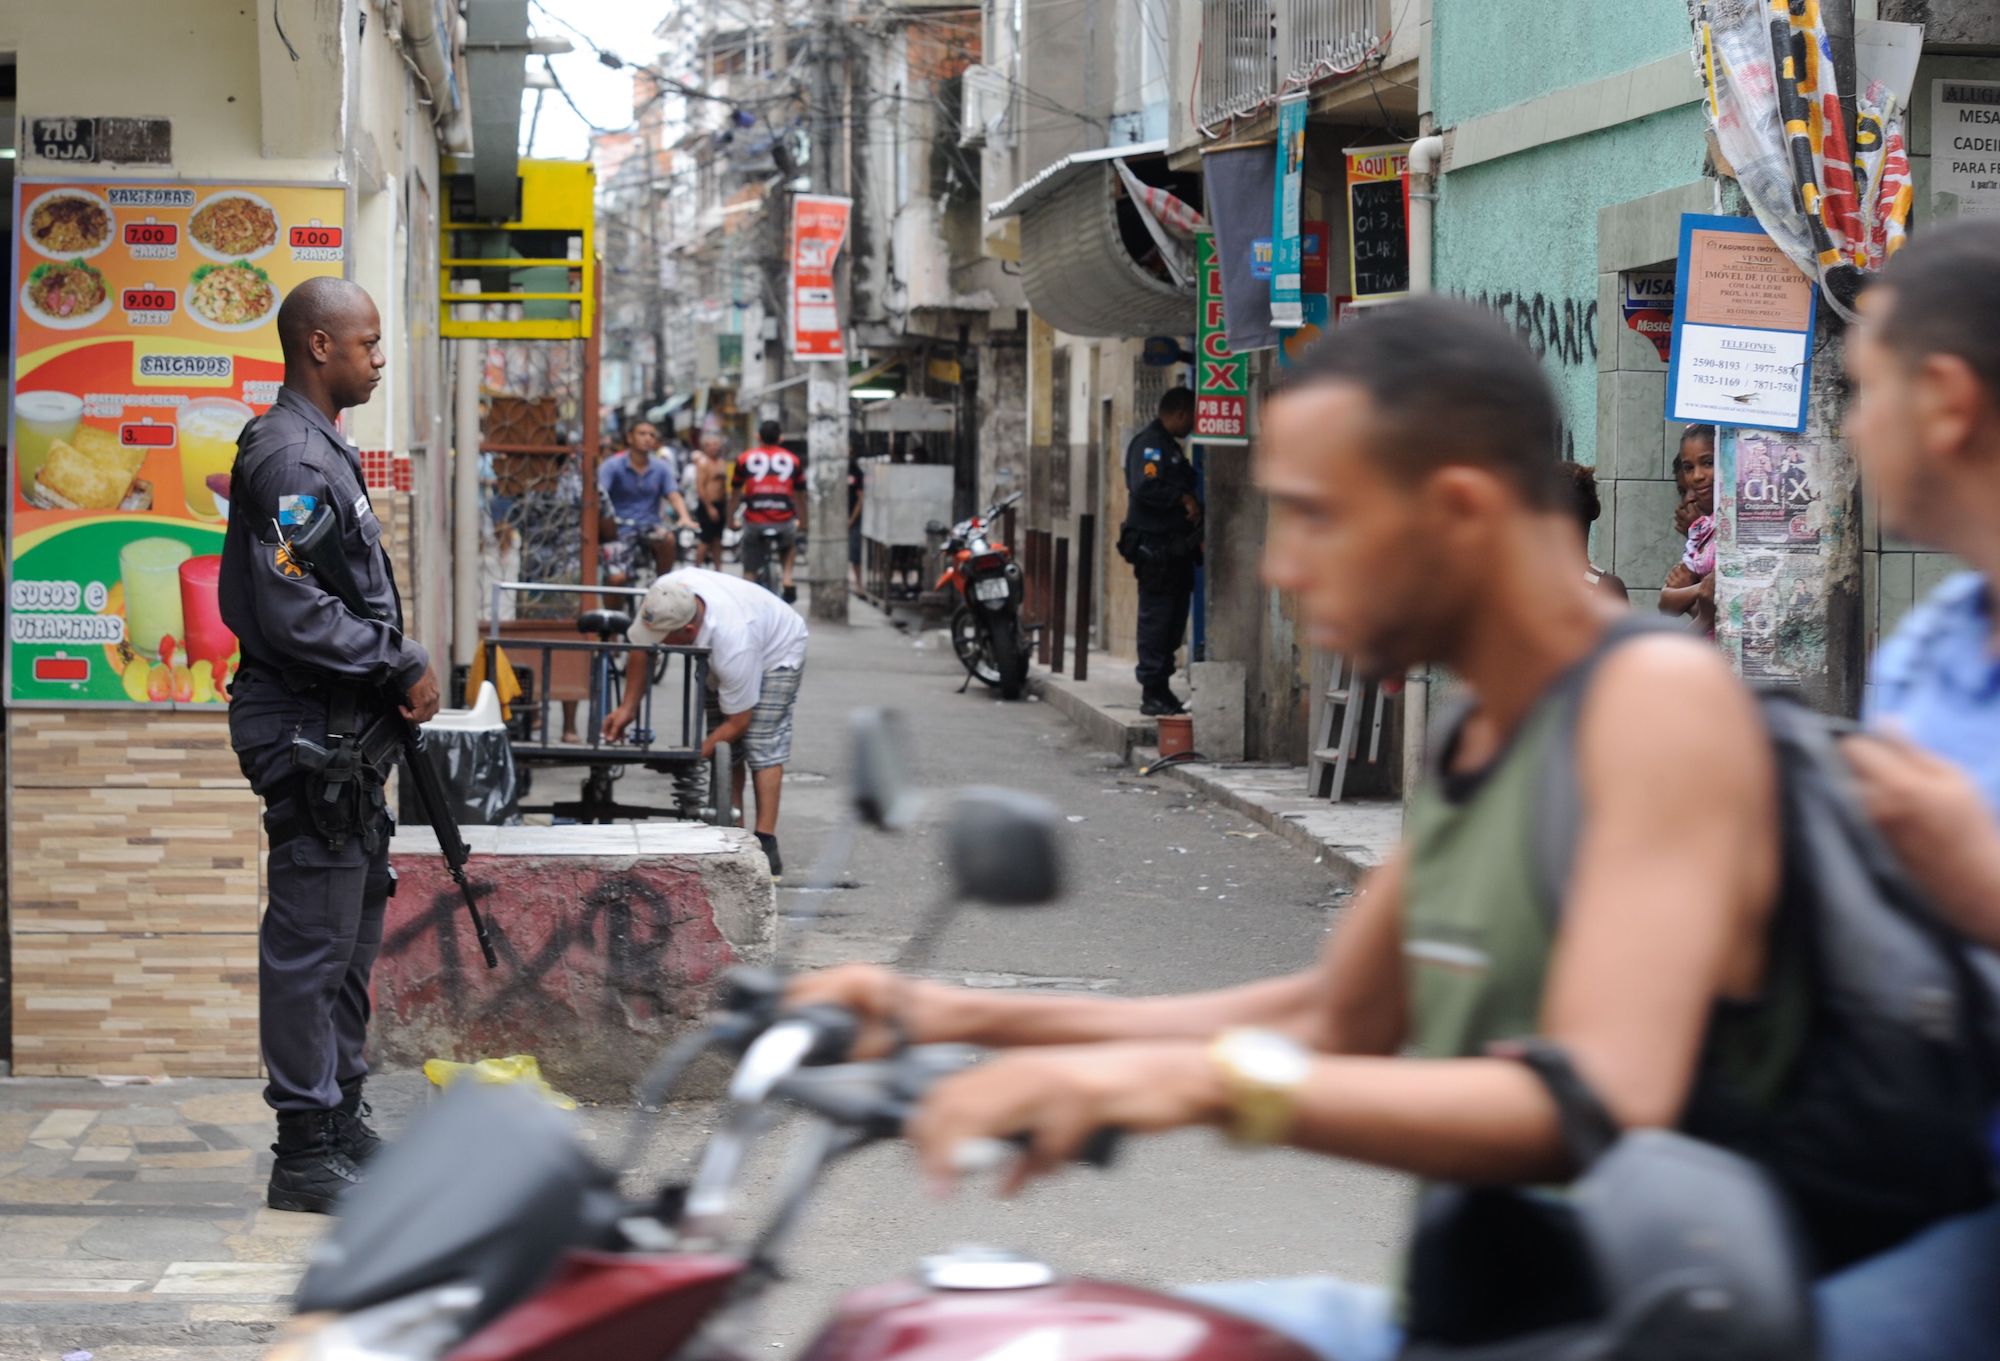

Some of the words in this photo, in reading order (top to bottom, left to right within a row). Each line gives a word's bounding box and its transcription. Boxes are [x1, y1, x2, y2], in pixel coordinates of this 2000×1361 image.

[39, 120, 78, 141] 716
[1953, 136, 2000, 152] CADEI
[1356, 158, 1387, 176] AQUI
[1952, 161, 1986, 174] PARA
[1742, 254, 1773, 263] VENDO
[1745, 273, 1758, 281] DE
[1766, 275, 1807, 285] QUARTO
[1634, 280, 1675, 295] VISA
[1763, 292, 1788, 300] BRASIL
[1720, 340, 1777, 352] TELEFONES:
[141, 356, 231, 377] SALGADOS
[1692, 357, 1741, 371] 2590-8193
[1692, 374, 1741, 388] 7832-1169
[1753, 380, 1798, 394] 7871-7581
[1198, 417, 1241, 433] CORES
[746, 450, 794, 482] 99
